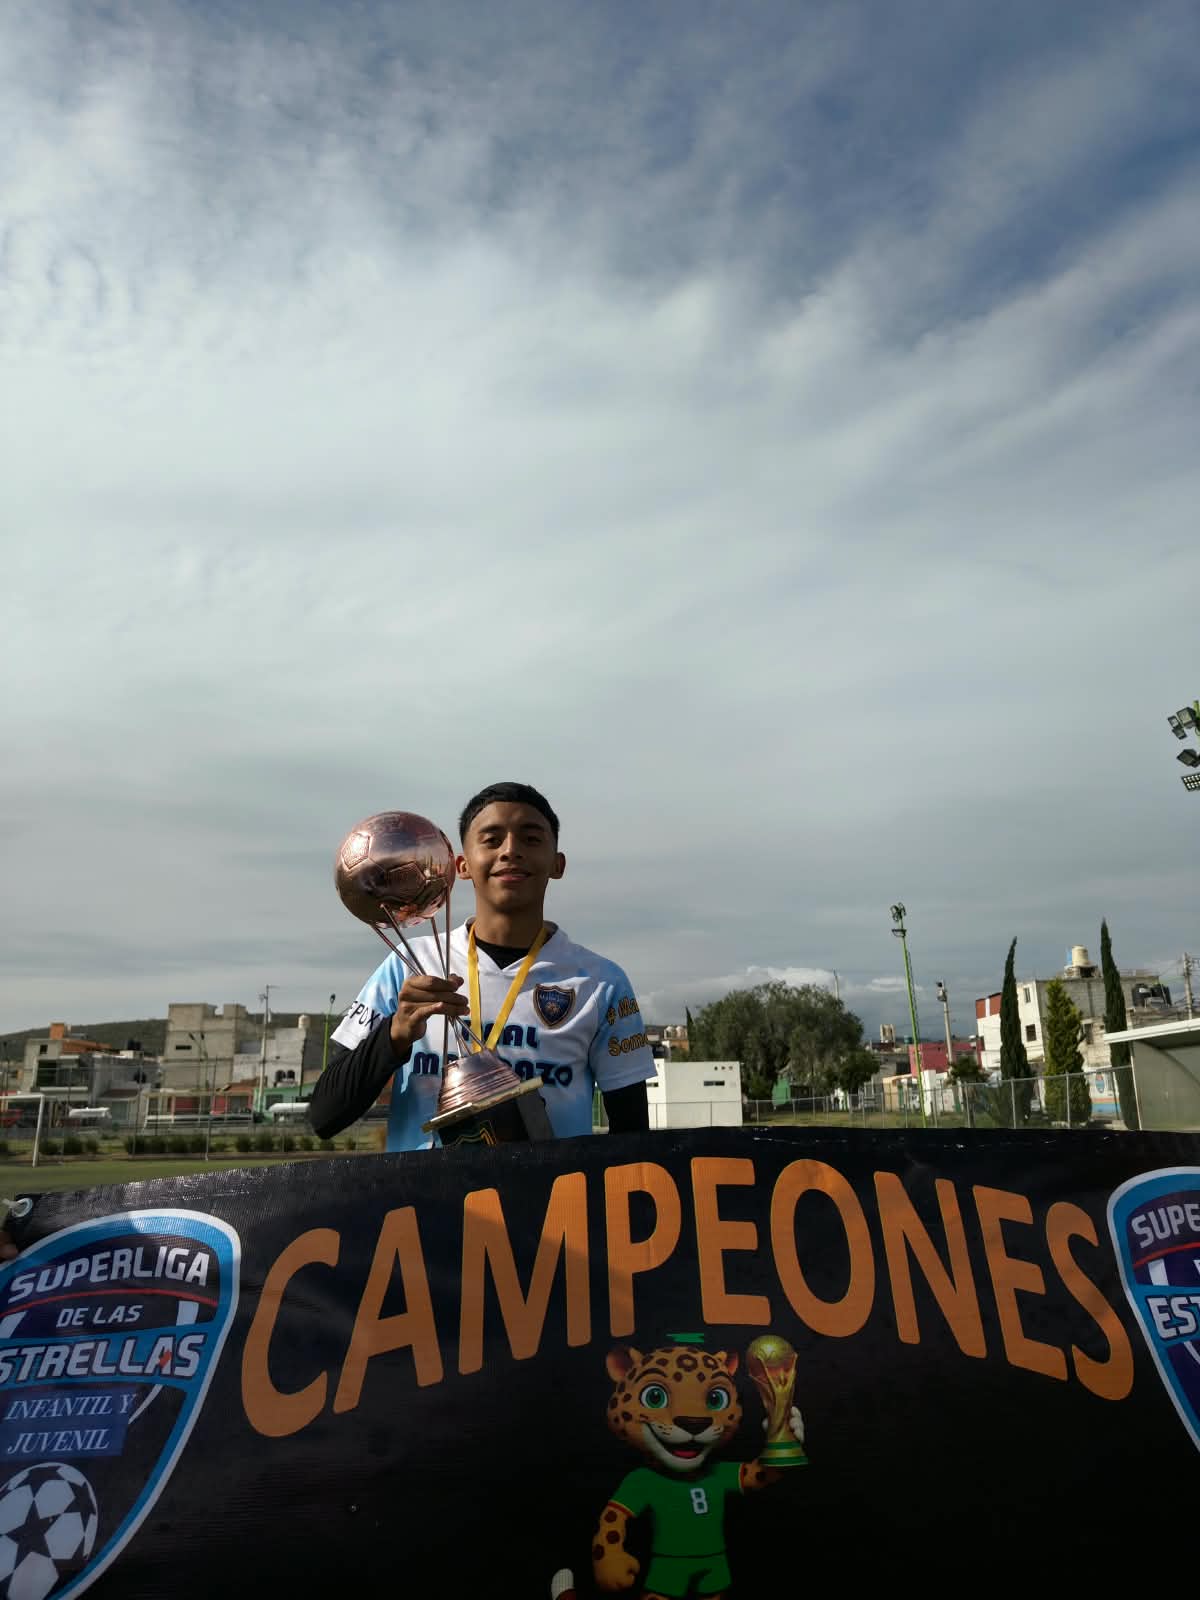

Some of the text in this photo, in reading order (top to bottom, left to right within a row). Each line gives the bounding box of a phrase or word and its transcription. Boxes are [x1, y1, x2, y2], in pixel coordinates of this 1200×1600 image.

[1131, 1203, 1200, 1249] SUPE
[8, 1246, 210, 1304] SUPERLIGA
[241, 1157, 1134, 1437] CAMPEONES
[56, 1304, 144, 1328] DE LAS
[0, 1334, 206, 1384] STRELLAS
[4, 1394, 138, 1421] INFANTIL Y
[8, 1428, 111, 1455] JUVENIL
[690, 1487, 708, 1514] 8
